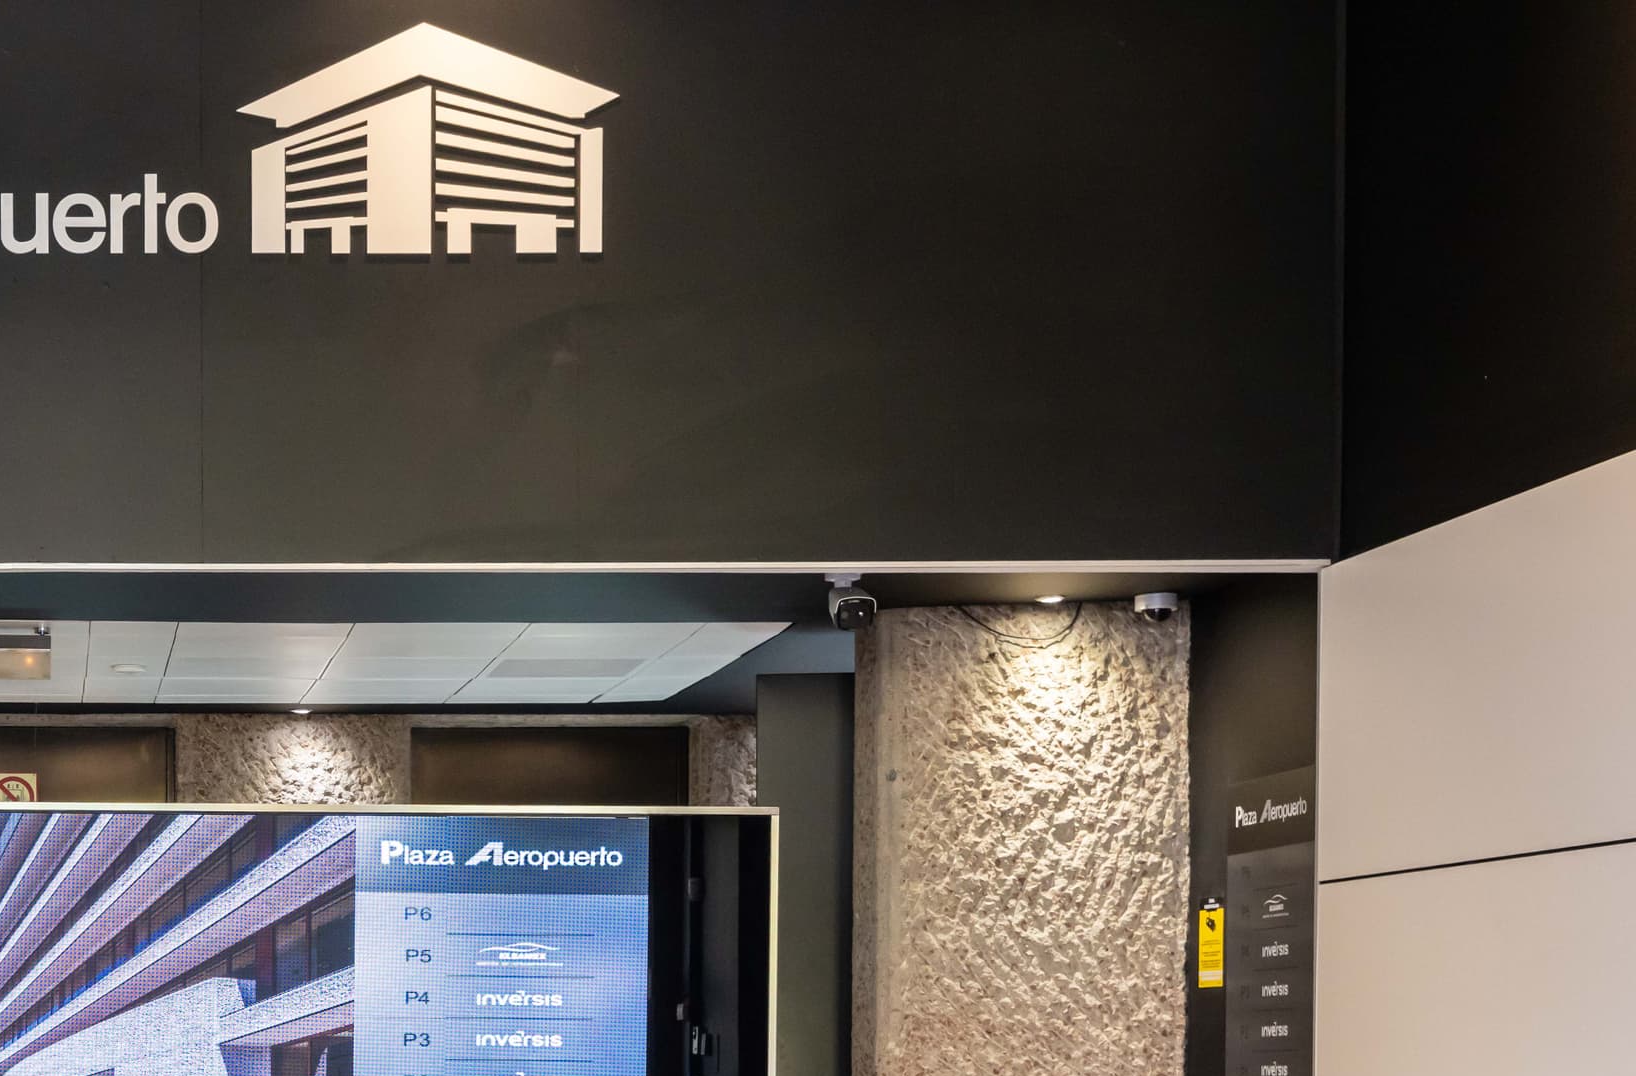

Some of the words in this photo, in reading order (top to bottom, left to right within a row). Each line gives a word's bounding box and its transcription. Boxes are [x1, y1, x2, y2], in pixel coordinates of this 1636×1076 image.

[1235, 805, 1257, 829] Plaza
[1259, 796, 1308, 823] Aeropuerto
[380, 840, 455, 866] Plaza
[465, 842, 623, 870] Aeropuerto
[404, 906, 432, 921] P6
[405, 949, 432, 963] P5
[405, 991, 430, 1005] P4
[476, 990, 563, 1006] inversis
[403, 1033, 431, 1047] P3
[476, 1030, 563, 1047] inversis
